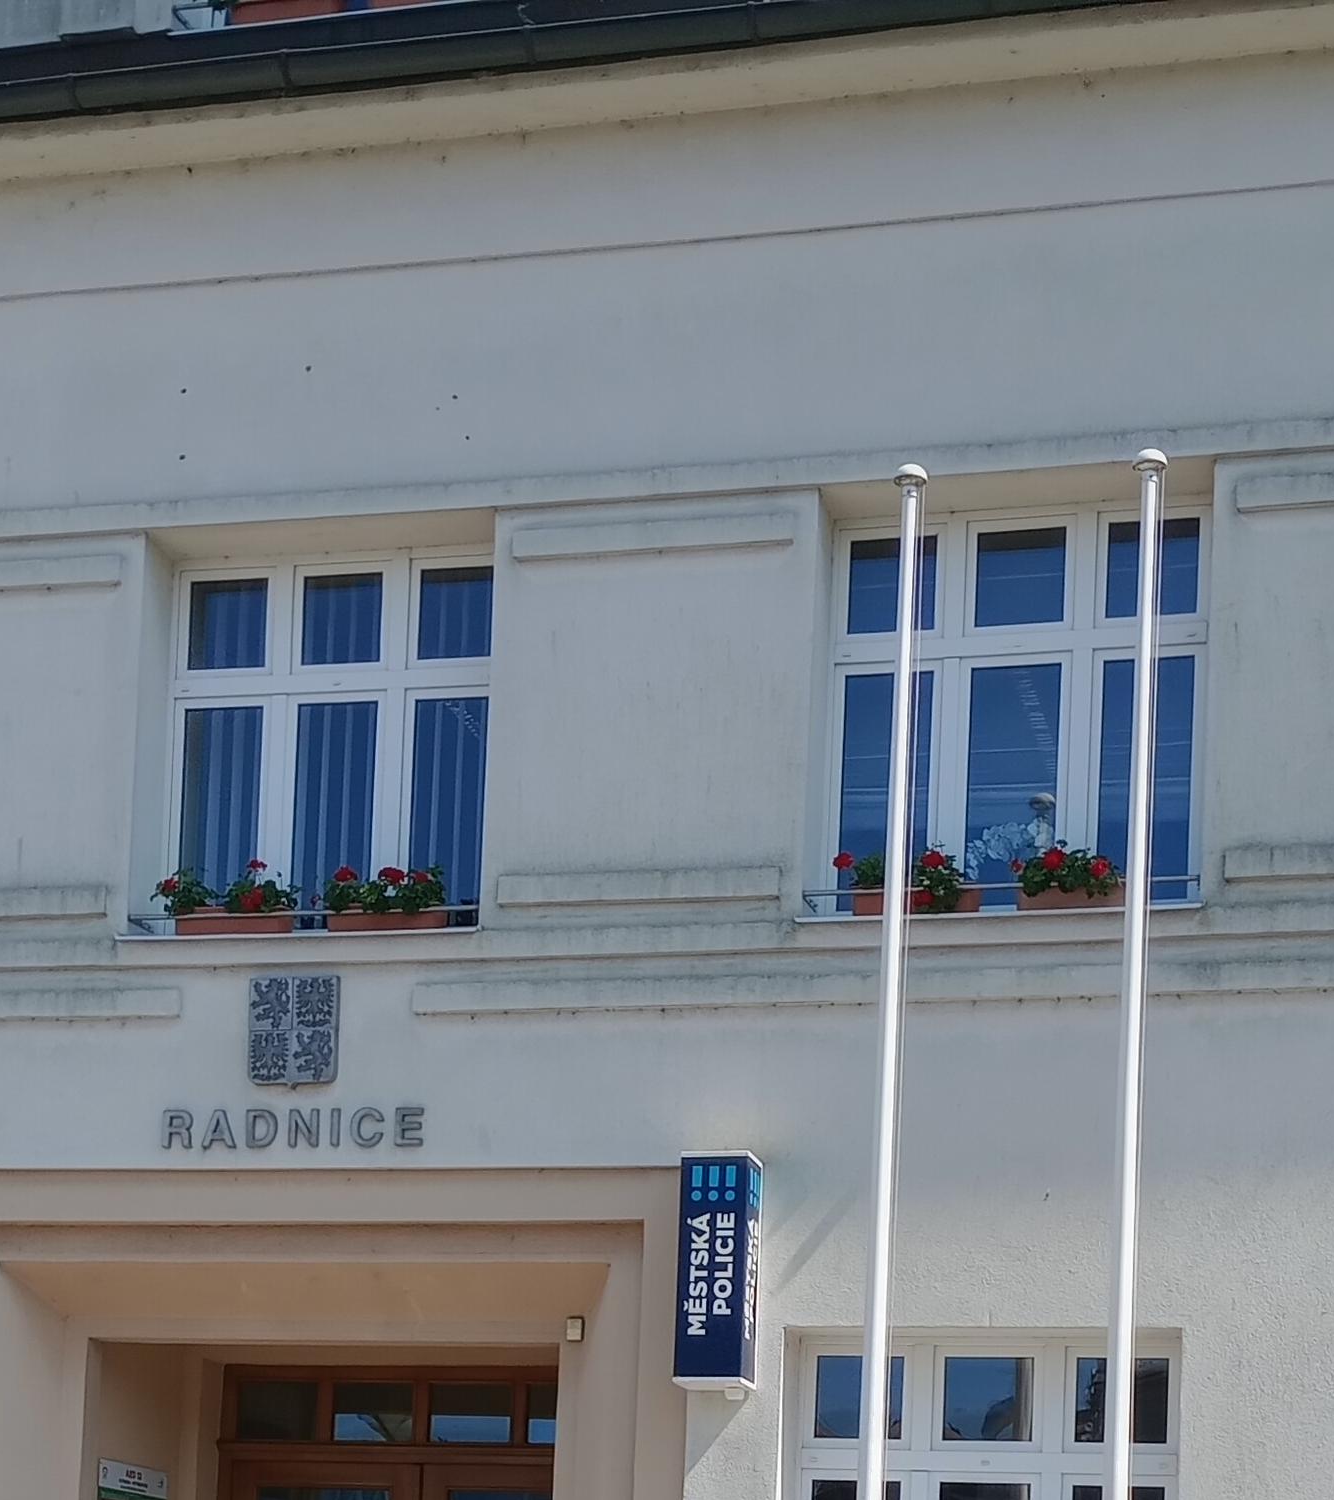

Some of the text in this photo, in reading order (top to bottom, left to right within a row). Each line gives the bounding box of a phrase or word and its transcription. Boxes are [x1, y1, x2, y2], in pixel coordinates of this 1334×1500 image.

[161, 1106, 426, 1151] RADNICE
[683, 1212, 712, 1336] MĚSTSKÁ
[712, 1212, 736, 1316] POLICIE
